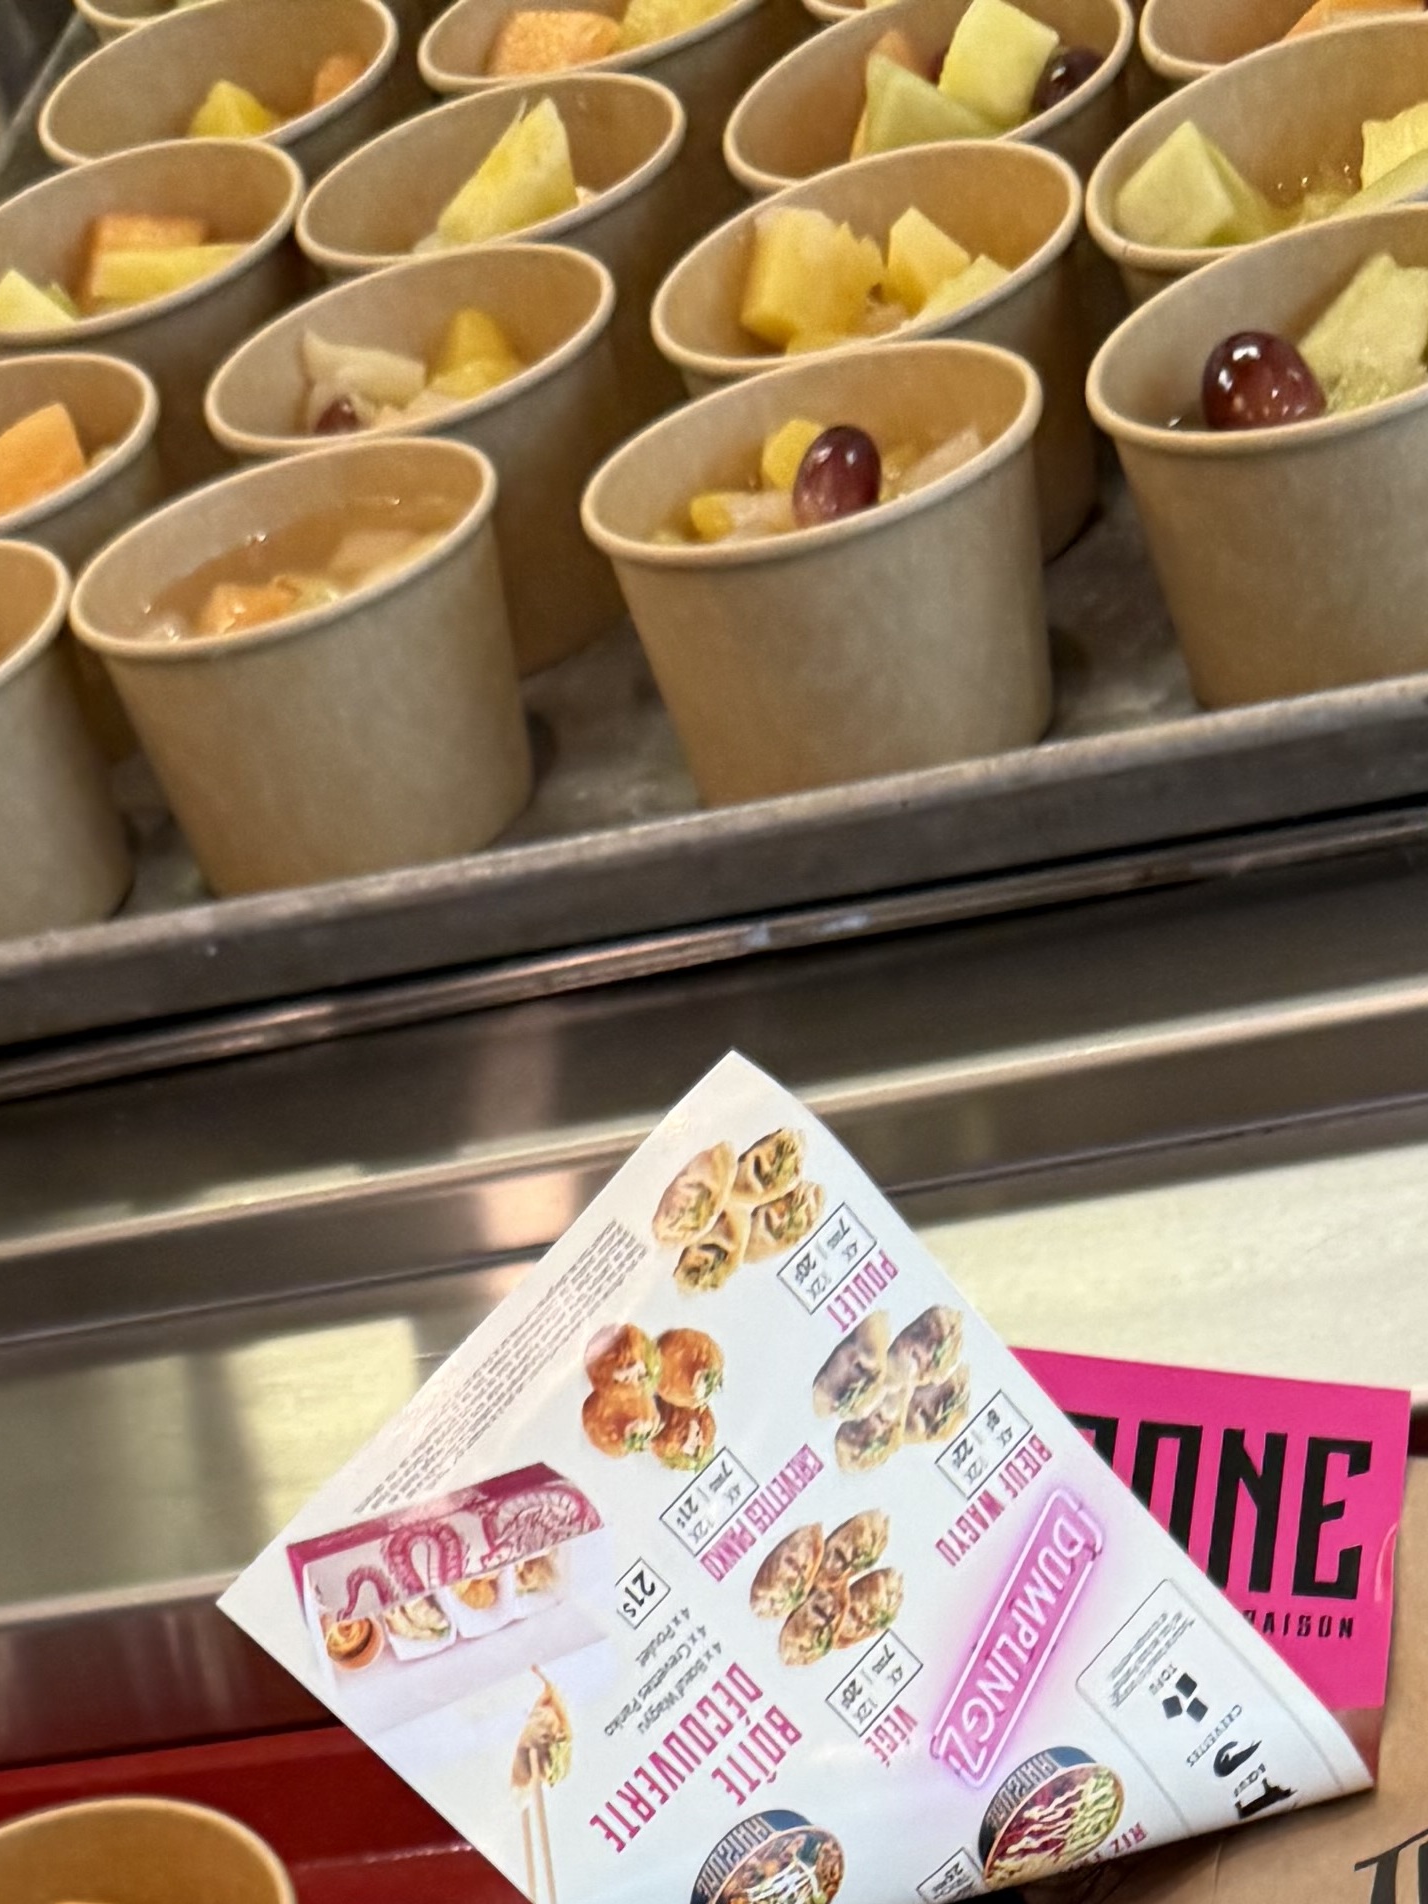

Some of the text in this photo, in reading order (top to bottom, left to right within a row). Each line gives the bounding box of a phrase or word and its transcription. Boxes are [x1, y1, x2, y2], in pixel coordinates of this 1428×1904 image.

[823, 1248, 899, 1333] POULET
[933, 1490, 1004, 1567] WAGYU
[1065, 1411, 1373, 1600] ONE
[937, 1515, 1086, 1773] DUMPLINGZ
[587, 1661, 764, 1853] DÉCOUVERTE
[709, 1703, 803, 1806] BOÎTE
[862, 1703, 919, 1770] VÉGÉ
